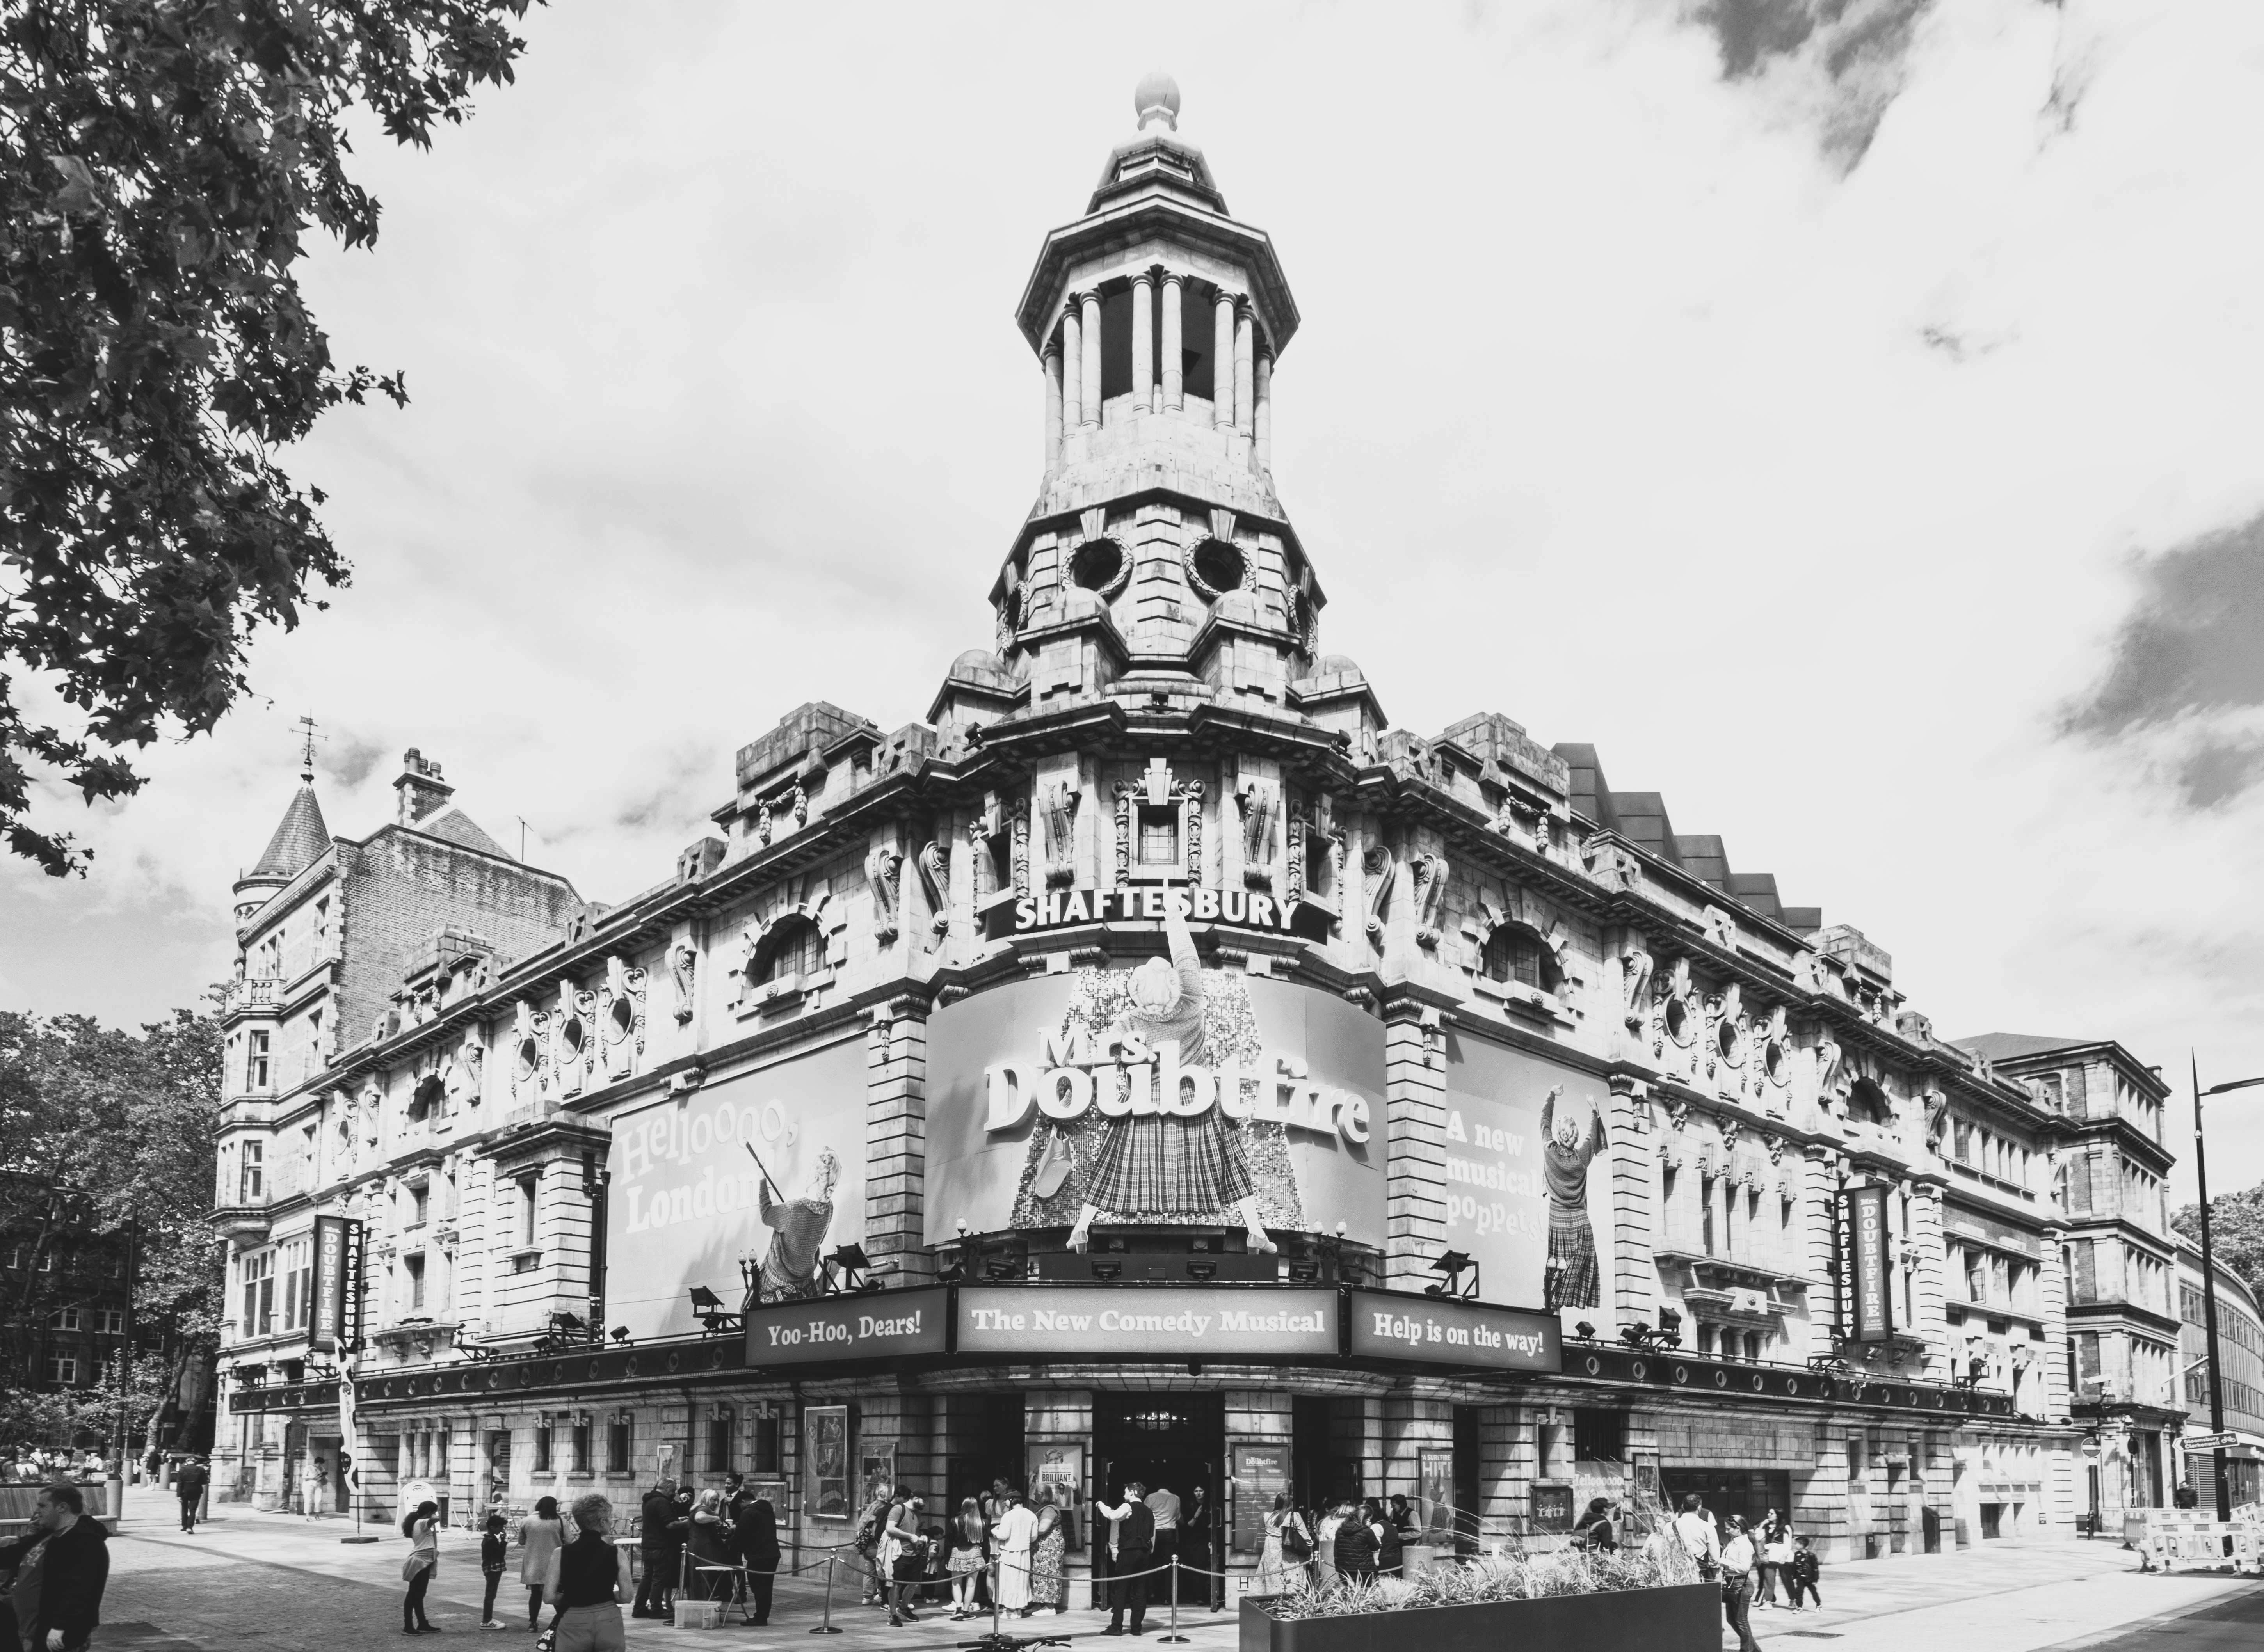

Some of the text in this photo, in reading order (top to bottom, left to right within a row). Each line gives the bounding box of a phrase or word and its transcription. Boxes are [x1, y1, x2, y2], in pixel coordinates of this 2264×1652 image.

[1016, 887, 1299, 929] SHAFTESBURY
[1036, 1022, 1157, 1067] Mrs.
[983, 1039, 1370, 1143] Doubtfire
[619, 1098, 799, 1185] Helloooo,
[1446, 1111, 1524, 1156] A new
[324, 1226, 341, 1234] Mrs.
[1446, 1194, 1546, 1242] poppets!
[320, 1233, 338, 1330] DOUBTFIRE
[1838, 1195, 1853, 1338] SHAFTESBURY
[1861, 1205, 1880, 1318] DOUBTFIRE
[344, 1224, 359, 1348] SHAFTESBURY
[767, 1310, 921, 1346] Yoo-Hoo, Dears!
[971, 1309, 1325, 1338] The New Comedy Musical
[1373, 1312, 1544, 1358] Help is on the way!
[2185, 1441, 2220, 1449] Clerkenwell
[1042, 1474, 1071, 1482] BRILLIANT
